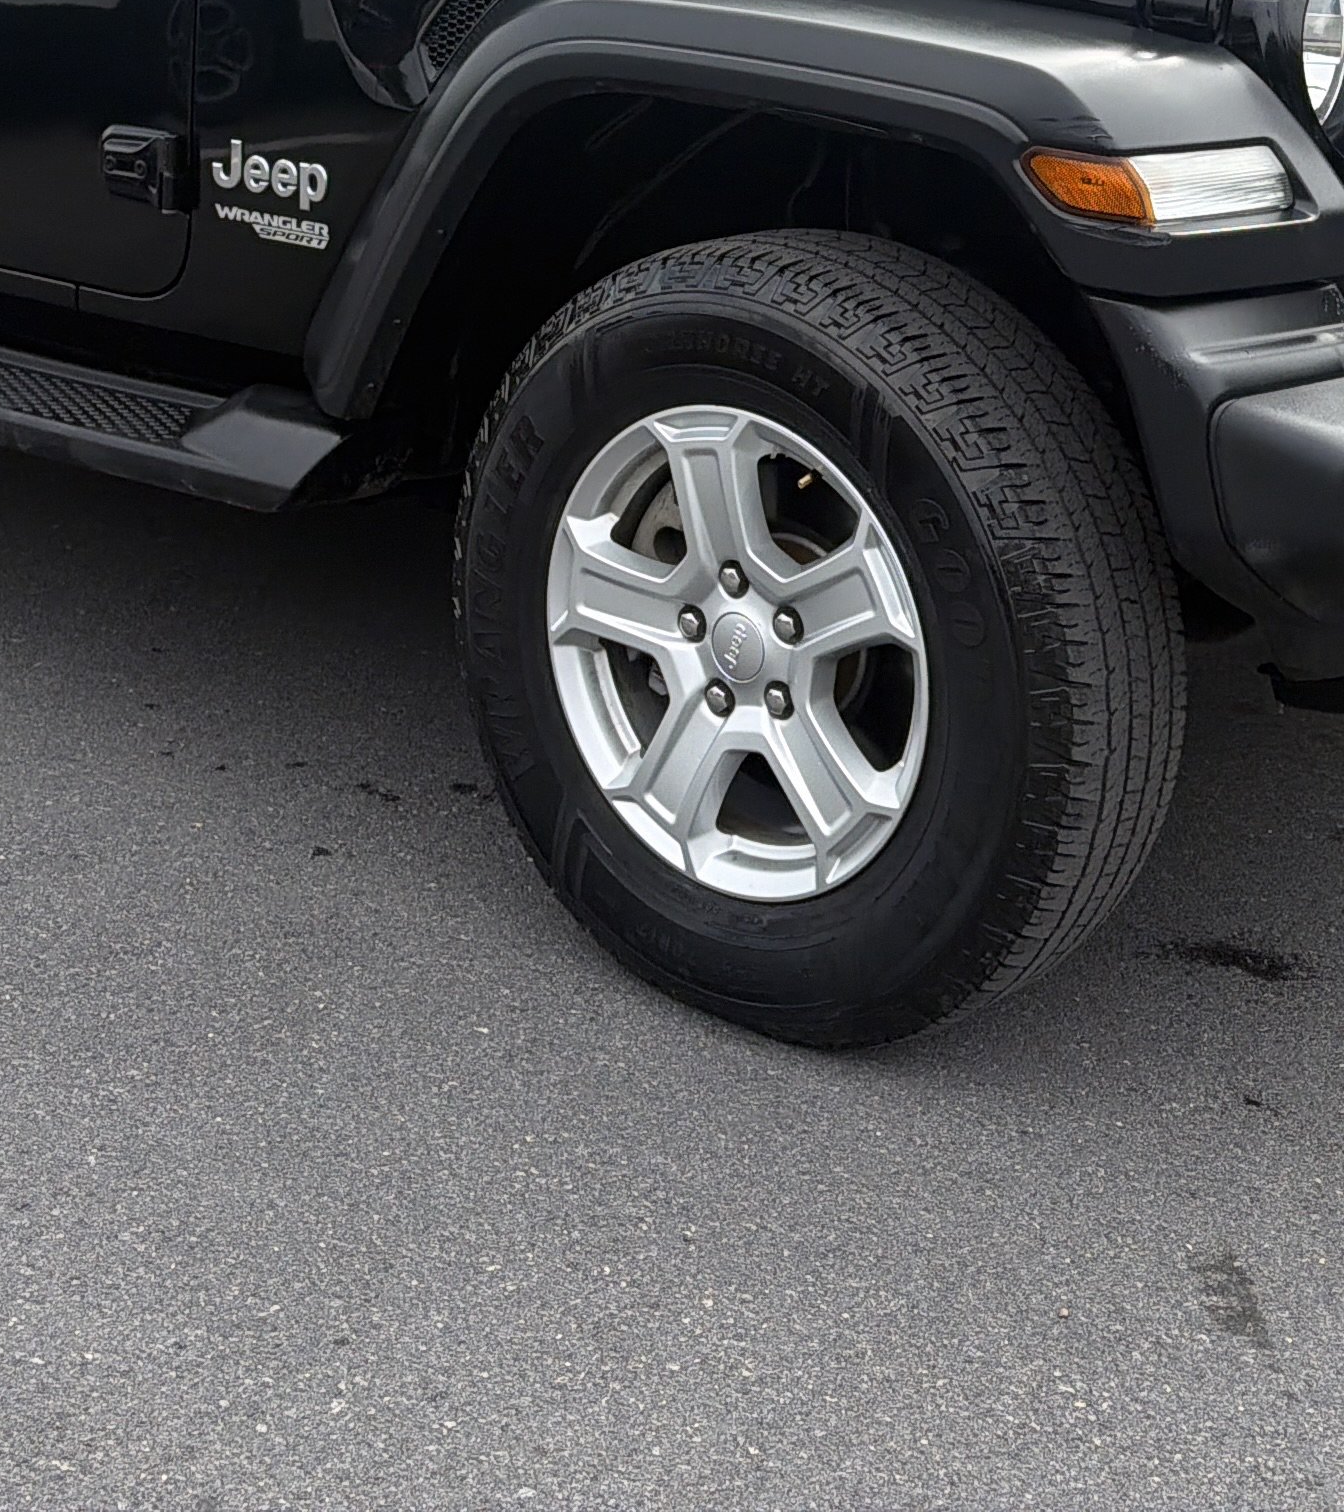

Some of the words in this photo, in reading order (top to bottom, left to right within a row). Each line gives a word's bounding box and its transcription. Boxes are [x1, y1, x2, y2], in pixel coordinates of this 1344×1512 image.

[211, 138, 328, 211] Jeep
[214, 202, 330, 237] WRANGLER
[256, 226, 329, 249] SPORT
